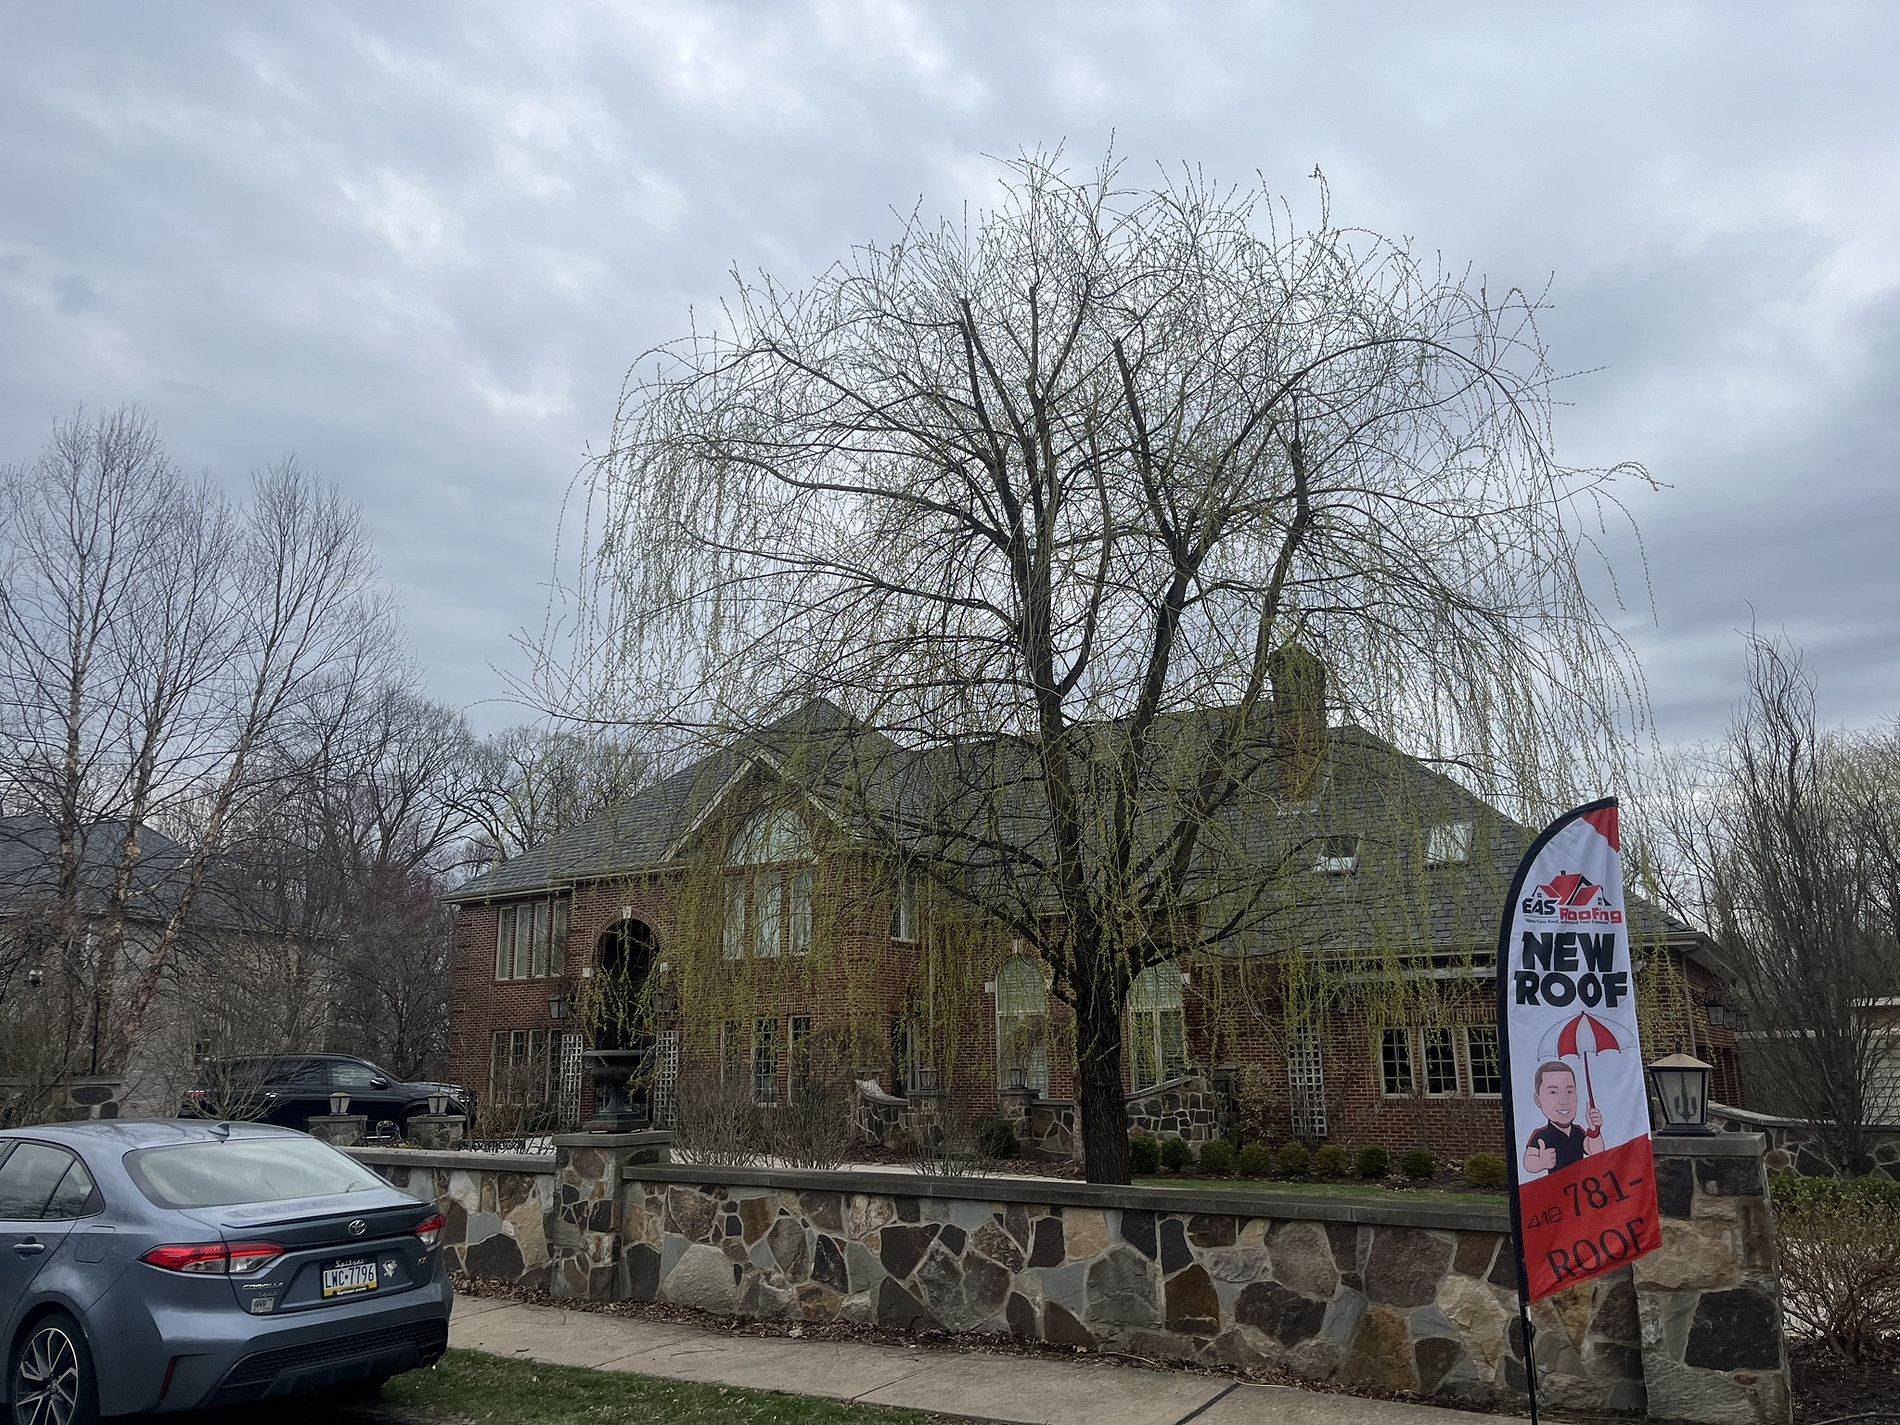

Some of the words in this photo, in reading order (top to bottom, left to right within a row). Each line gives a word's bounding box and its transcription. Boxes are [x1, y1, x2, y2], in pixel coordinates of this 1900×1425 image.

[1522, 898, 1558, 915] EAS
[1522, 931, 1615, 972] NEW
[1514, 970, 1628, 1008] ROOF
[1546, 1217, 1646, 1283] ROOF
